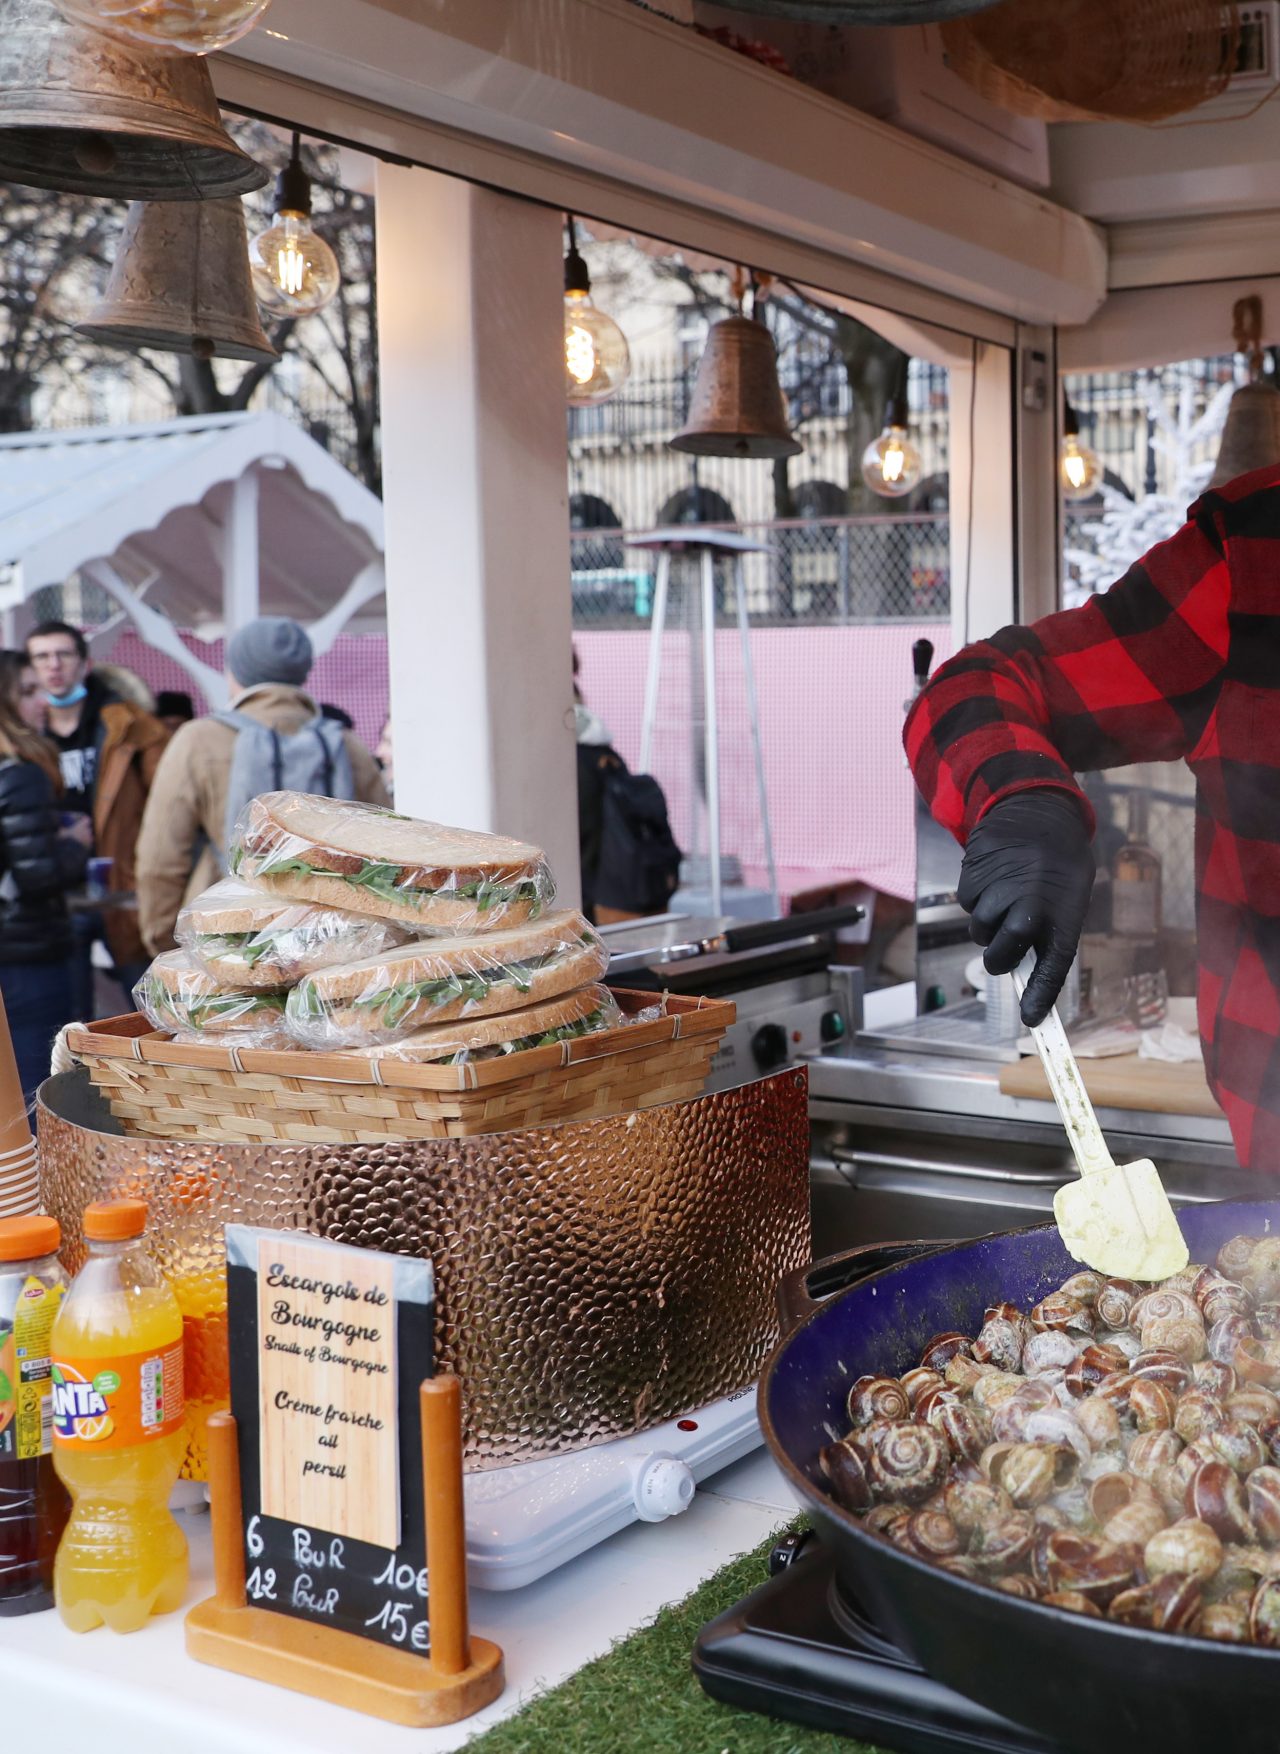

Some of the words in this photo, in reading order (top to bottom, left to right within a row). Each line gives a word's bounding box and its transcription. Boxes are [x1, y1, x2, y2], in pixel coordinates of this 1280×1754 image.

[266, 1263, 360, 1304] Escargots
[364, 1285, 389, 1306] de
[271, 1300, 382, 1346] Bourgogne
[264, 1335, 302, 1355] Snails
[303, 1346, 316, 1363] of
[319, 1346, 389, 1376] Bourgogne
[318, 1434, 338, 1448] ail
[303, 1460, 346, 1479] persil
[247, 1515, 264, 1557] 6
[373, 1554, 430, 1597] 10€
[246, 1566, 277, 1600] 12
[365, 1600, 432, 1649] 15€
